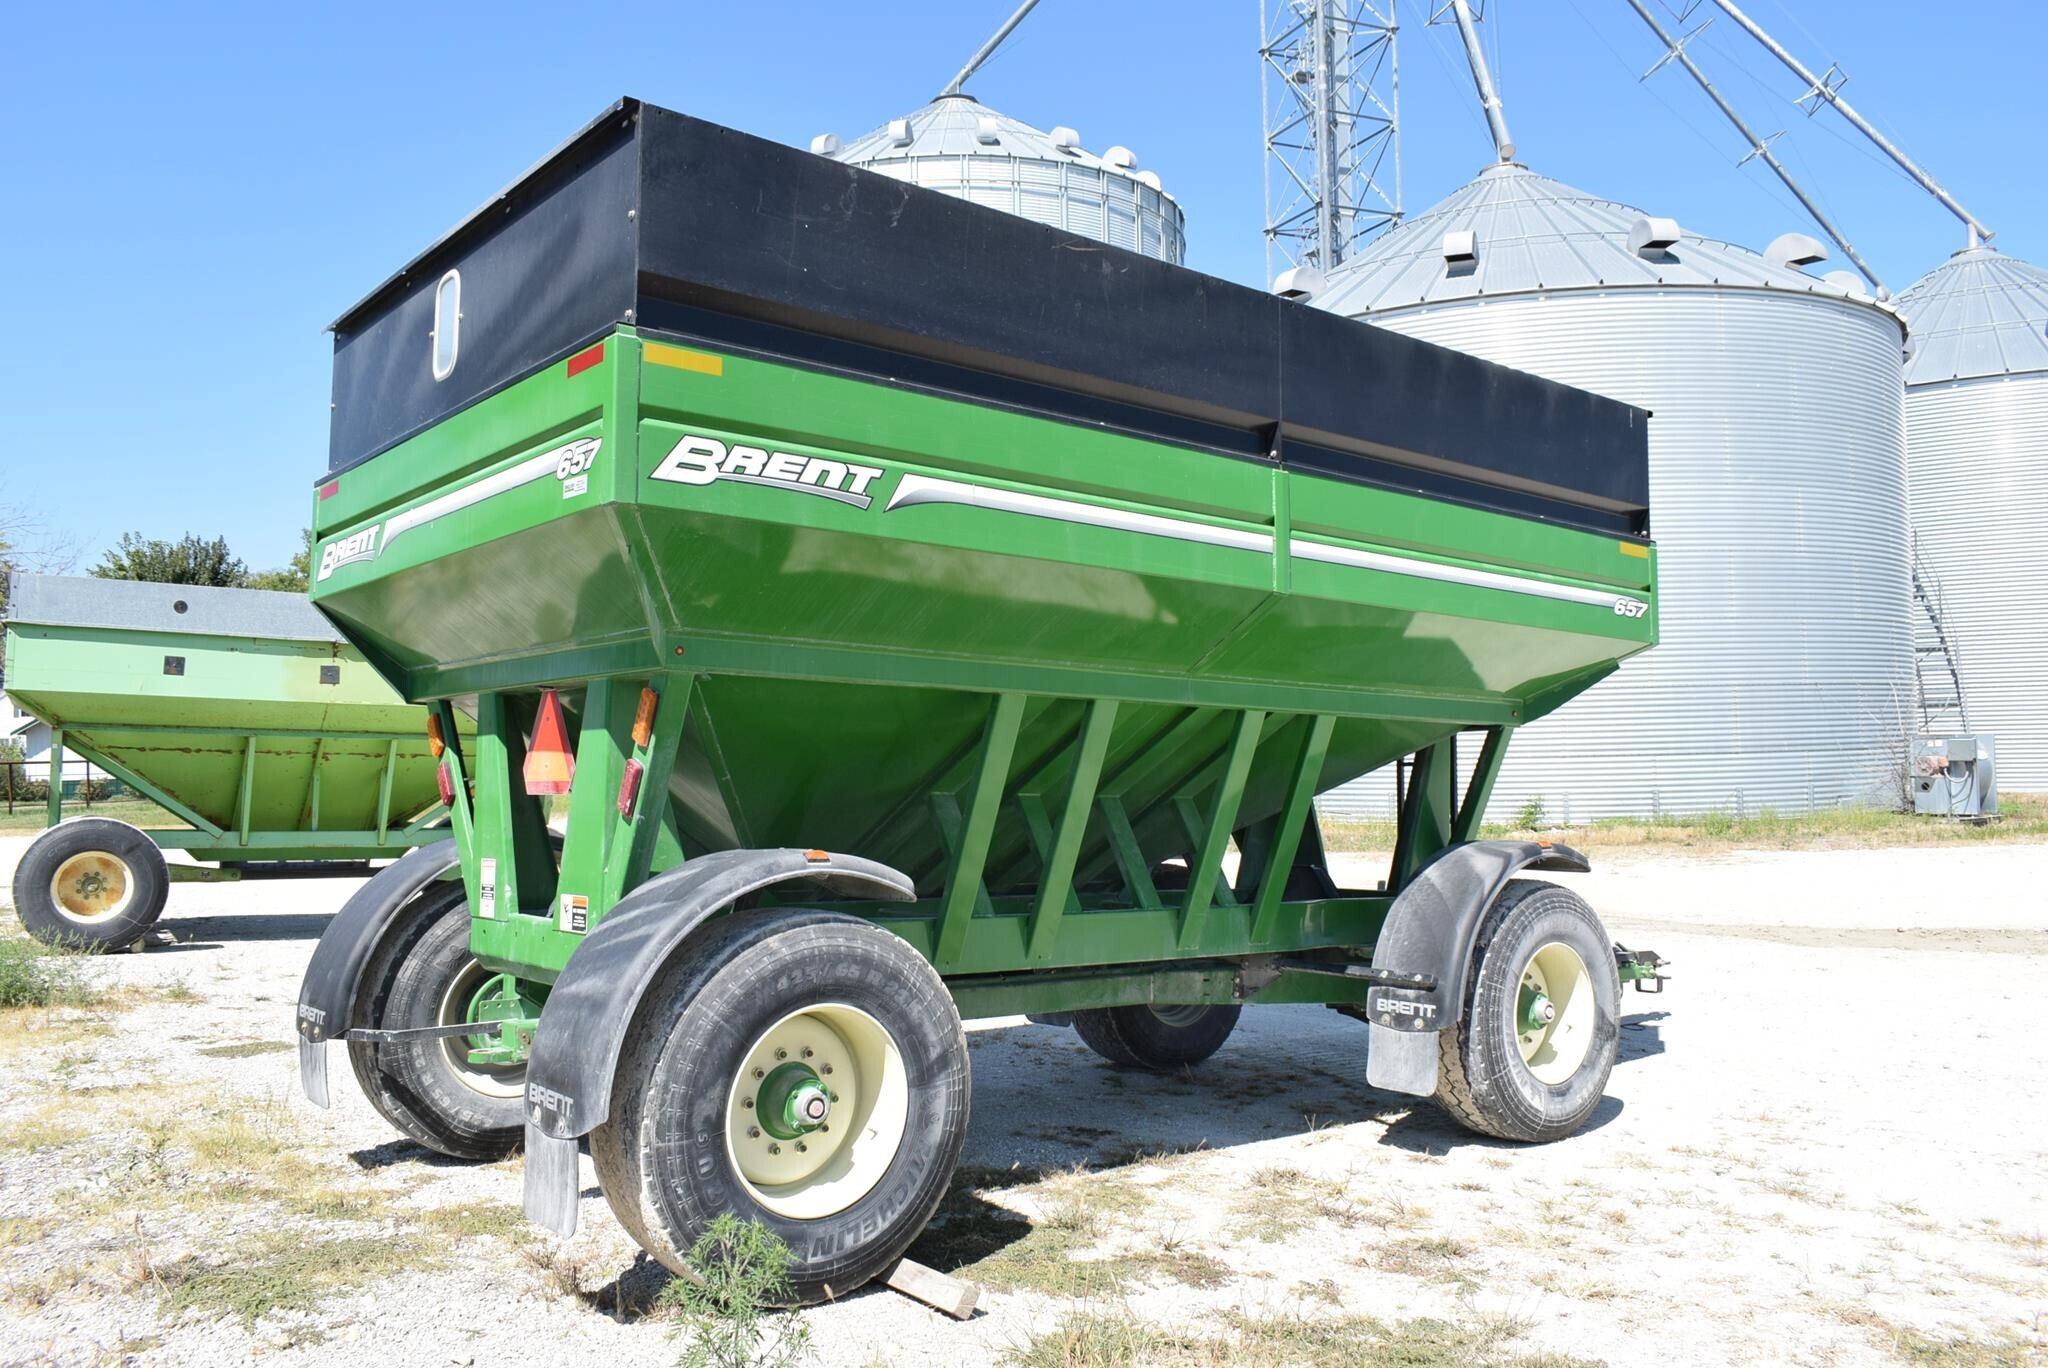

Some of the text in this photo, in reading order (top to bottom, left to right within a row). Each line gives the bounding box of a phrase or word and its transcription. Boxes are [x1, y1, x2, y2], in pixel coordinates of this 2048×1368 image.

[556, 437, 603, 480] 657
[648, 433, 885, 496] BRENT
[316, 524, 380, 582] BRENT
[1613, 598, 1649, 618] 657
